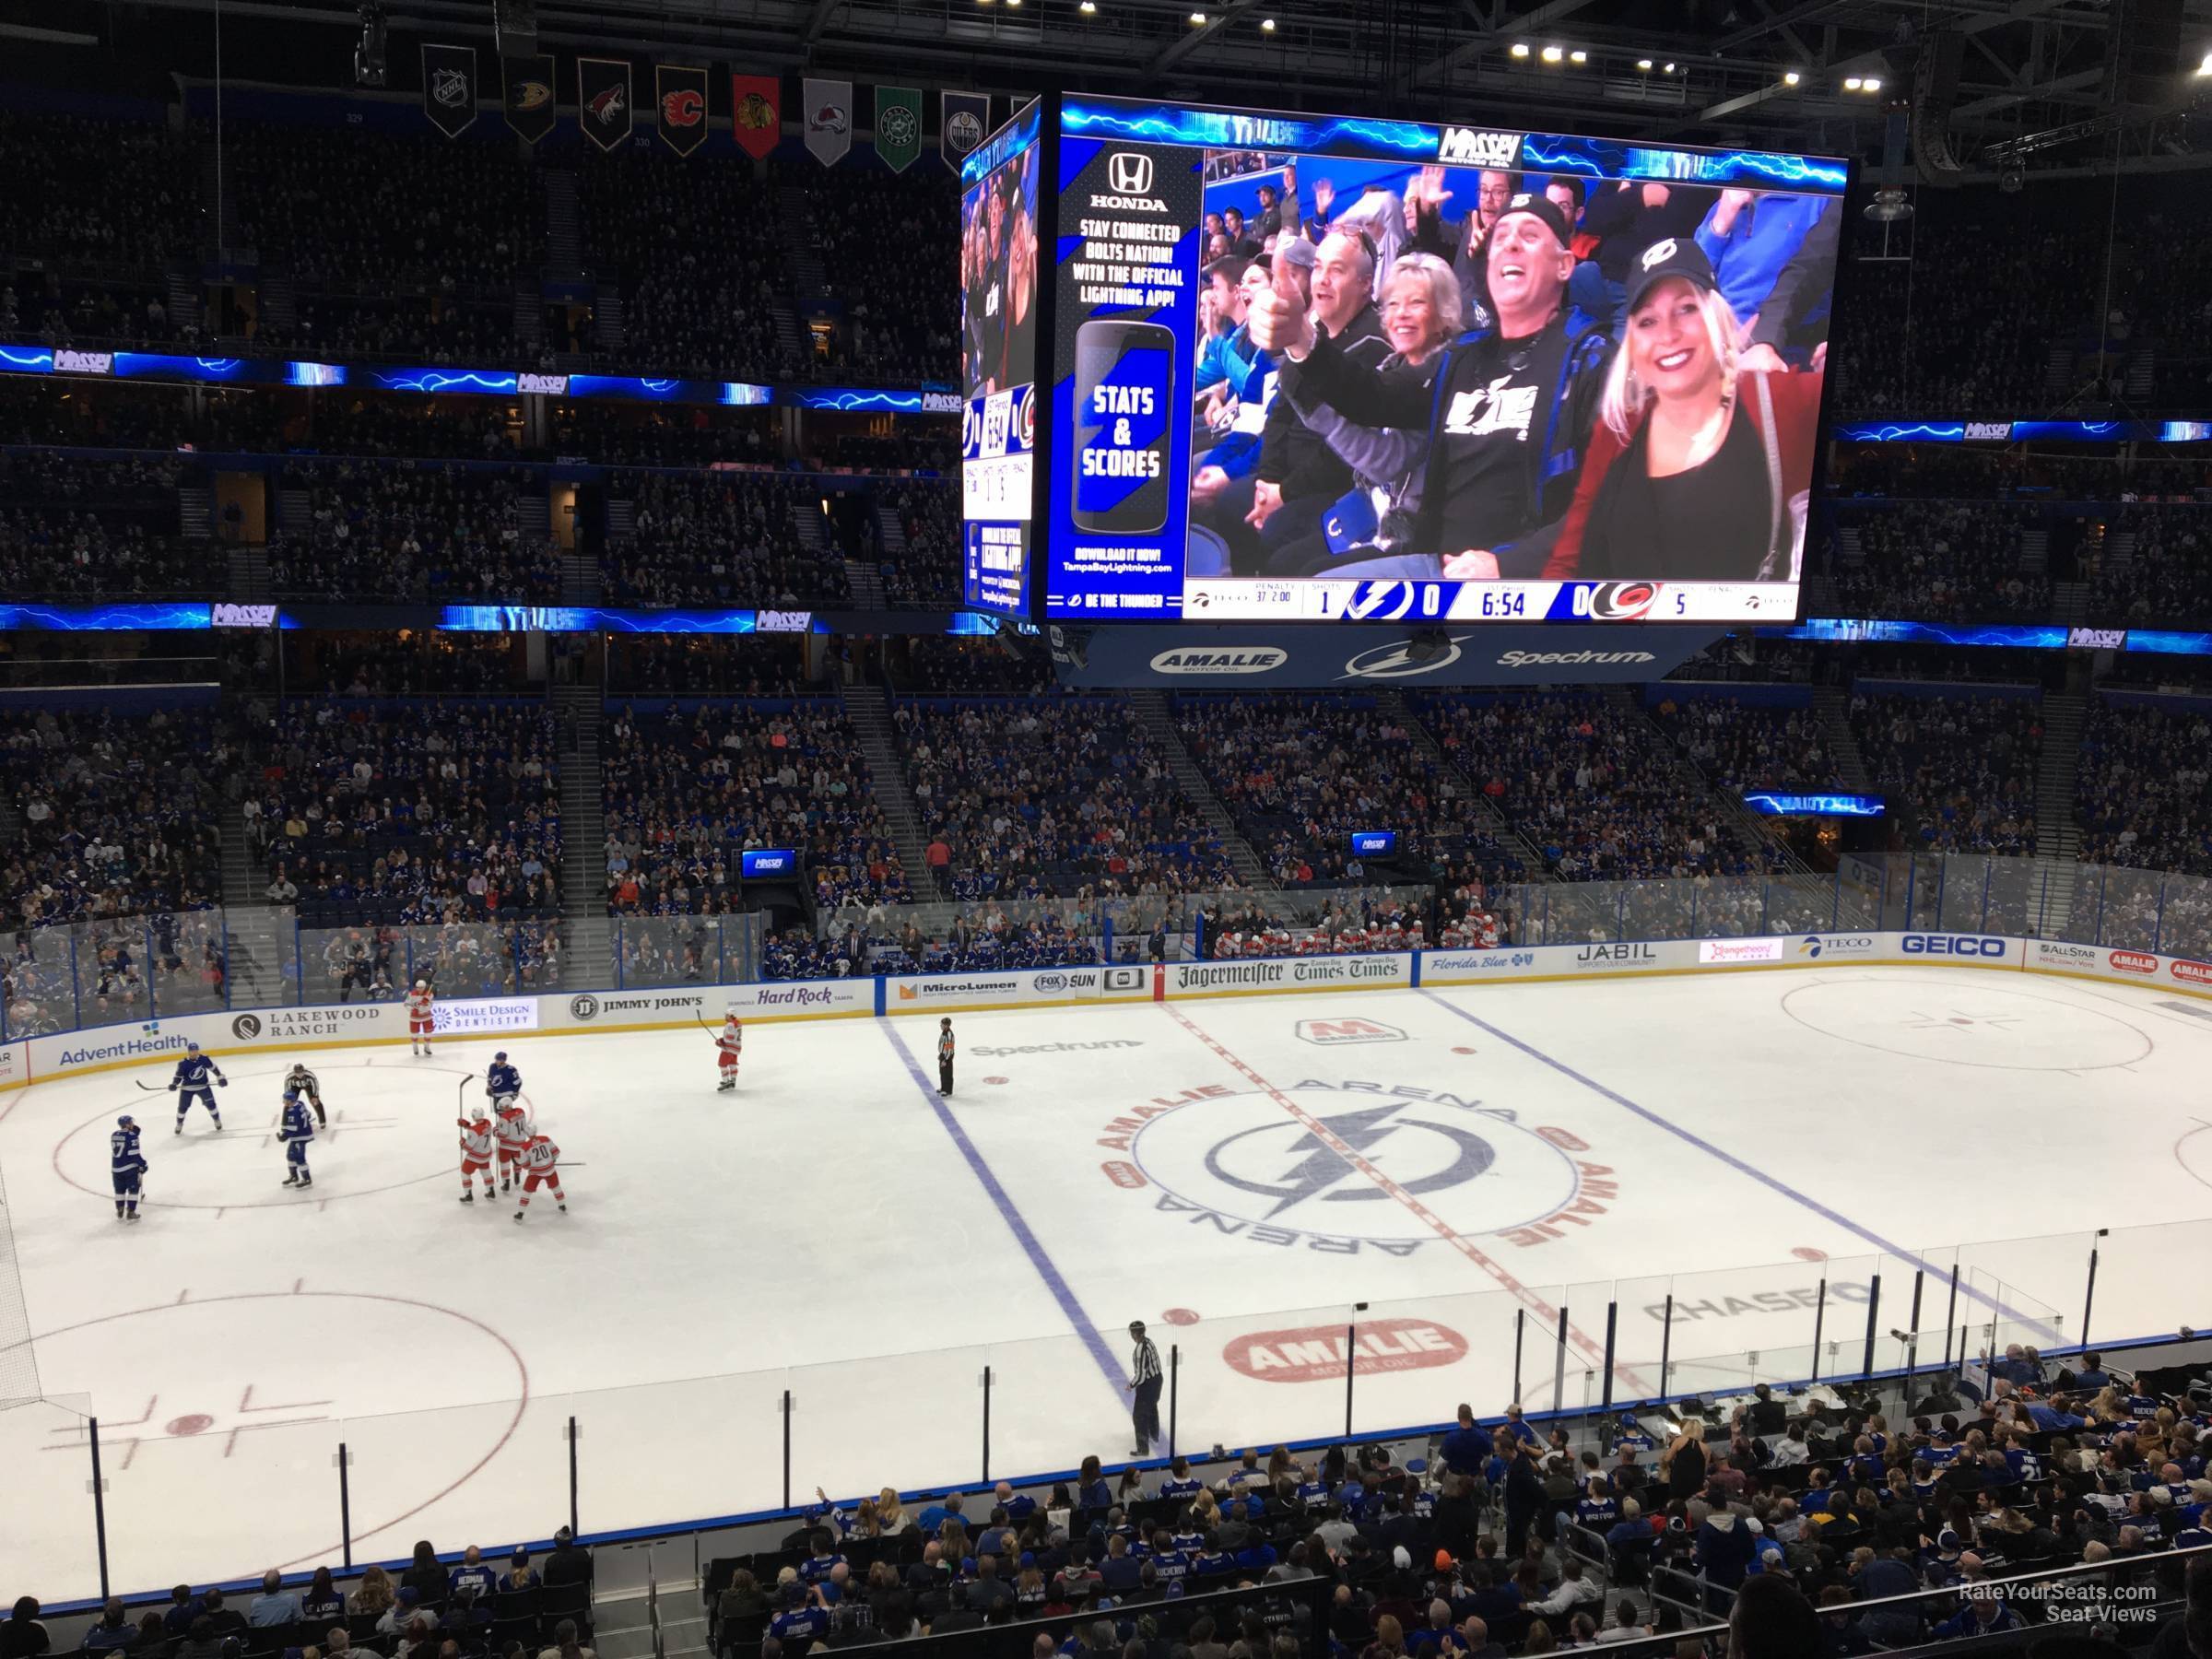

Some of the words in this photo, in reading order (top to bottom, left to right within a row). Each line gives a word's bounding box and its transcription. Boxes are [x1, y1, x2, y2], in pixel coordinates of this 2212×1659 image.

[441, 79, 462, 98] NHL
[951, 126, 978, 138] OILERS
[1439, 127, 1521, 162] MASSEY
[1090, 194, 1169, 213] HONDA
[1080, 218, 1109, 237] STAY
[1112, 220, 1180, 243] CONNECTED
[1086, 243, 1124, 261] BOLTS
[1125, 245, 1173, 264] NATION!
[1073, 263, 1104, 281] WITH
[1106, 265, 1130, 282] THE
[1132, 266, 1183, 287] OFFICIAL
[1080, 285, 1144, 306] LIGHTNING
[1146, 288, 1175, 307] APP!
[53, 348, 112, 370] MASSEY
[517, 373, 569, 392] MASSEY
[1094, 385, 1154, 415] STATS
[1113, 418, 1131, 445] &
[1964, 422, 2011, 439] MASSEY
[1082, 448, 1160, 477] SCORES
[1075, 547, 1125, 561] DOWNLOAD
[1126, 547, 1135, 561] IT
[1136, 548, 1161, 562] NOW!
[1063, 561, 1172, 574] TampaBayLightning.com
[1085, 593, 1099, 607] BE
[1100, 594, 1118, 607] THE
[1119, 594, 1163, 608] THUNDER
[1256, 592, 1266, 602] 37
[1321, 592, 1328, 614] 1
[1422, 584, 1440, 616] 0
[1482, 593, 1525, 616] 6:54
[1572, 585, 1590, 616] 0
[1677, 594, 1686, 615] 5
[213, 604, 276, 625] MASSEY
[756, 609, 810, 629] MASSEY
[2068, 627, 2126, 647] MASSEY
[1159, 654, 1279, 666] AMALIE
[1497, 650, 1655, 667] Spectrum
[1578, 944, 1657, 960] JABIL
[1824, 938, 1872, 948] TECO
[1901, 935, 2006, 957] GEICO
[1294, 962, 1344, 981] Times
[1349, 959, 1398, 978] Times
[1431, 956, 1477, 970] Florida
[1481, 956, 1509, 967] Blue
[2112, 955, 2155, 969] AMALIE
[1041, 977, 1061, 985] FOX
[1070, 974, 1096, 988] SUN
[1179, 962, 1284, 989] Jägermeister
[758, 987, 795, 1006] Hard
[796, 986, 832, 1005] Rock
[923, 982, 1017, 993] MicroLumen
[453, 1006, 487, 1017] SMILE
[488, 1005, 530, 1016] DESIGN
[603, 998, 650, 1013] JIMMY
[653, 996, 703, 1010] JOHN'S
[270, 1007, 380, 1024] LAKEWOOD
[455, 1016, 529, 1028] DENTISTRY
[271, 1024, 338, 1038] RANCH
[59, 1035, 189, 1065] AdventHealth
[971, 1040, 1146, 1057] Spectrum
[1294, 1078, 1518, 1122] ARENA
[1097, 1083, 1236, 1152] AMALIE
[532, 1145, 549, 1162] 20
[1495, 1159, 1619, 1248] AMALIE
[1154, 1194, 1425, 1257] ARENA
[1643, 1288, 1835, 1323] CHASE
[1248, 1327, 1453, 1371] AMALIE
[1311, 1360, 1375, 1376] MOTOR
[1382, 1358, 1416, 1368] OIL
[457, 1574, 485, 1586] HEDMAN
